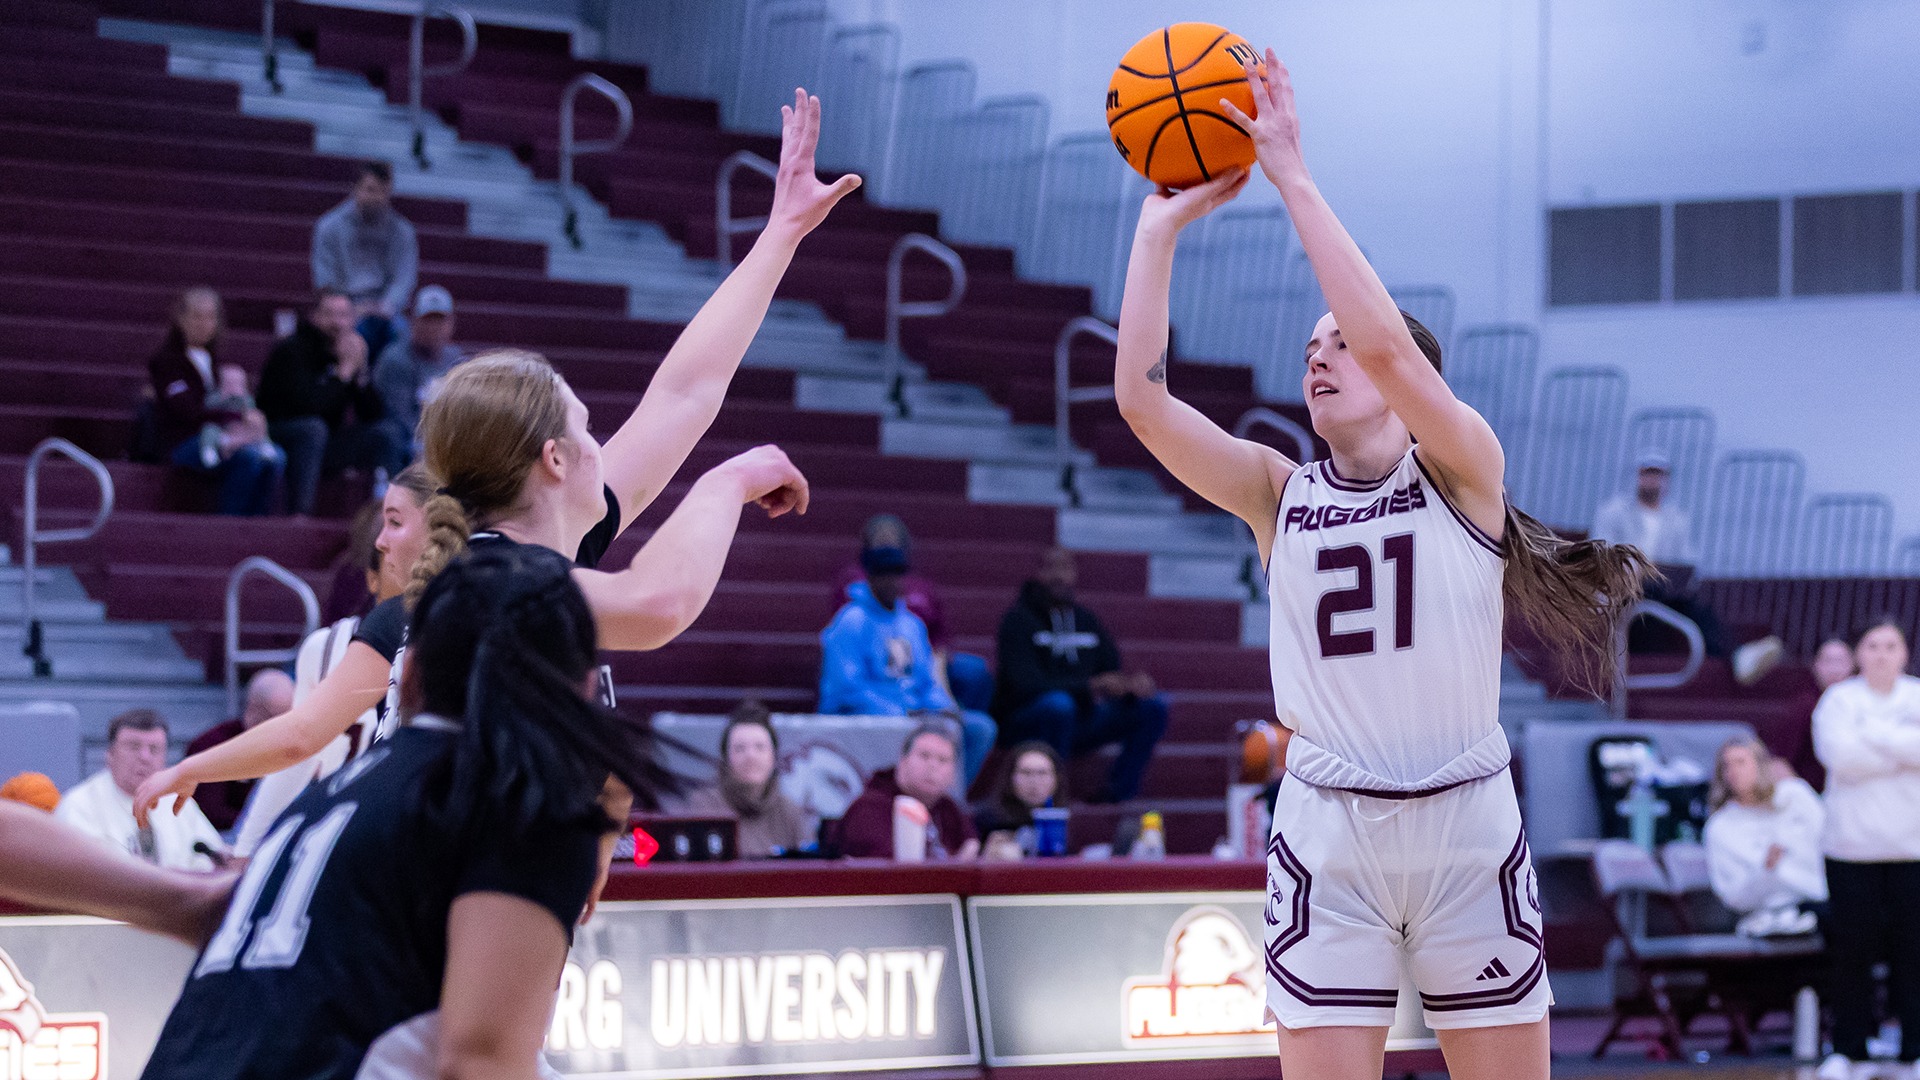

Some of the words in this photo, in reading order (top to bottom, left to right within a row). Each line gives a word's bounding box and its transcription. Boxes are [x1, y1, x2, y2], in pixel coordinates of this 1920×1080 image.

[1285, 478, 1427, 534] AUGGIES
[1315, 531, 1416, 660] 21
[194, 801, 359, 979] 11
[650, 947, 946, 1050] UNIVERSITY
